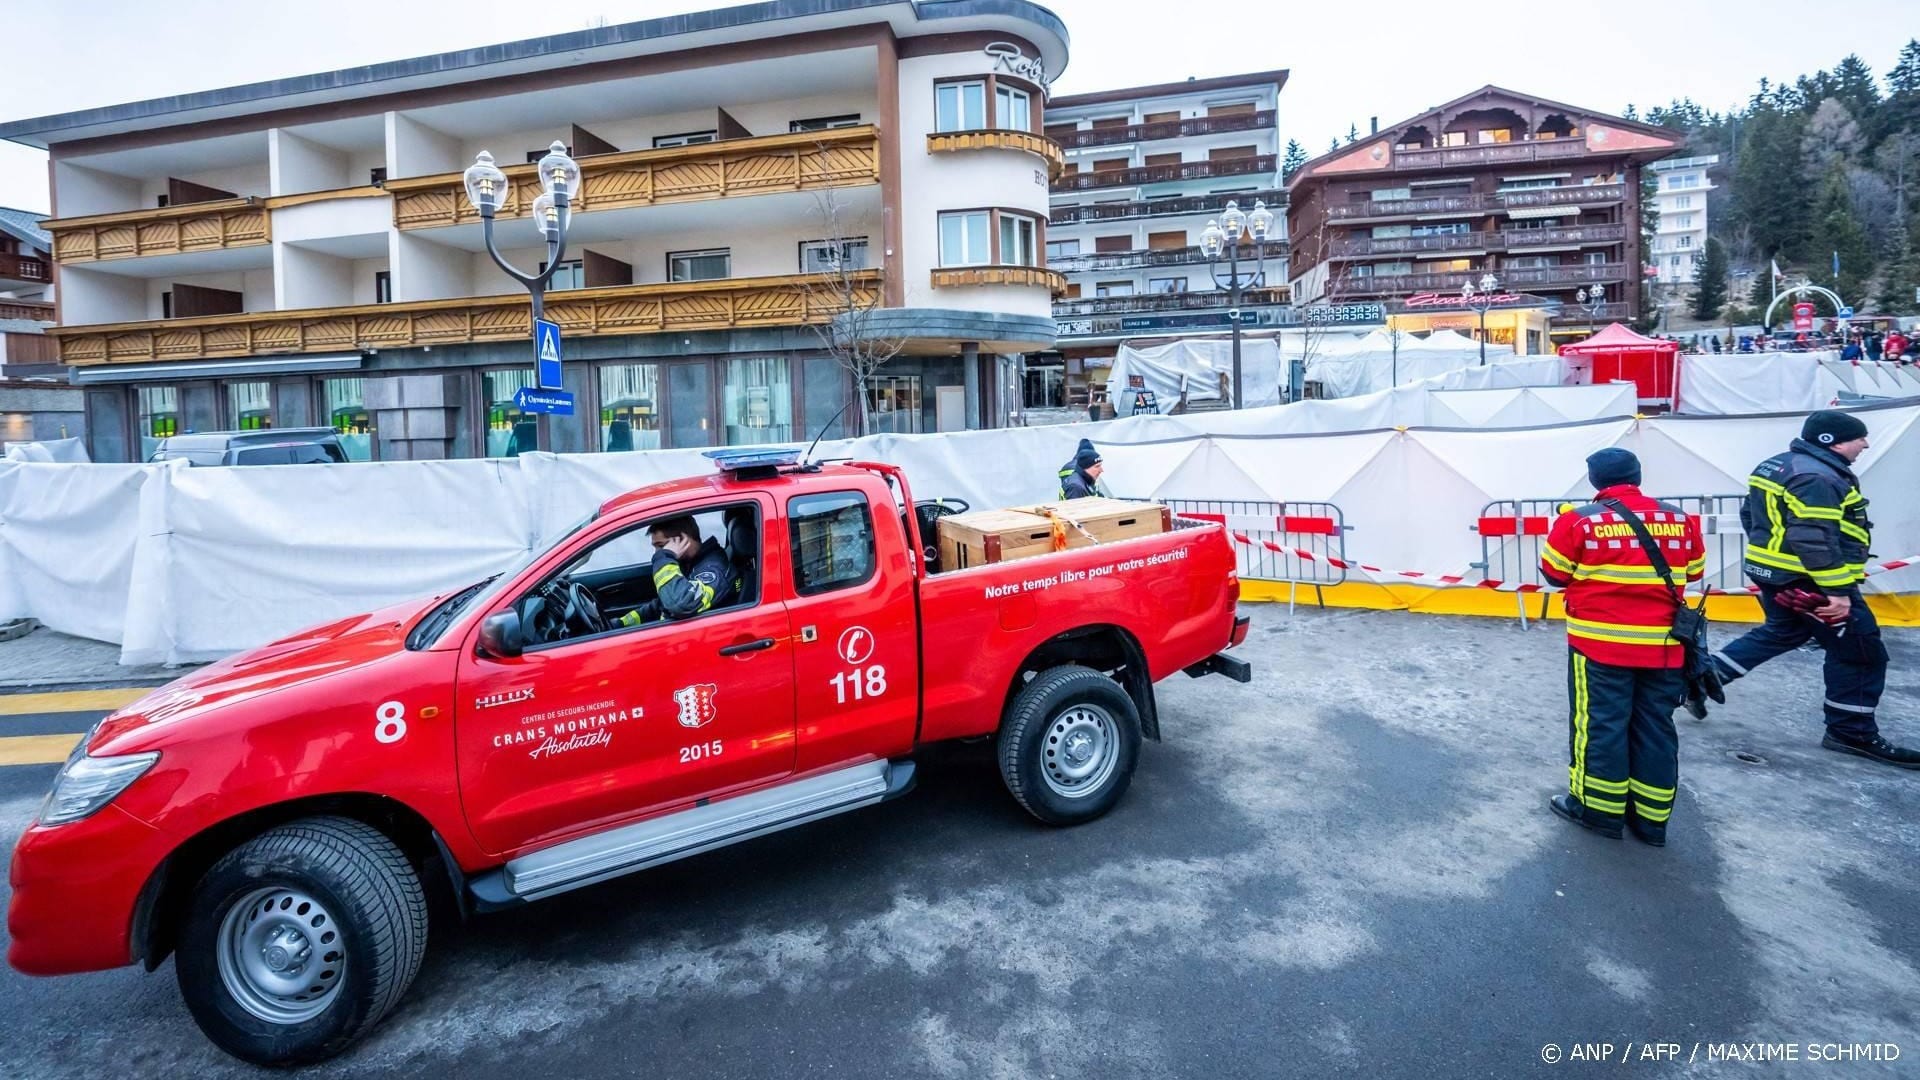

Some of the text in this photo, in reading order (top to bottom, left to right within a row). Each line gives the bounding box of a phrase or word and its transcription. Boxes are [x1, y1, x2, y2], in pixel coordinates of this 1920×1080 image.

[1594, 523, 1685, 538] COMMNDANT
[985, 547, 1188, 600] Notre temps libre pour votre sécurité!
[475, 687, 536, 710] HILUX
[829, 664, 887, 704] 118
[374, 700, 407, 744] 8
[521, 699, 616, 725] CENTRE DE SECOURS INCENDIE
[493, 710, 628, 748] CRANS MONTANA
[529, 728, 613, 760] Absolutely
[679, 740, 723, 764] 2015
